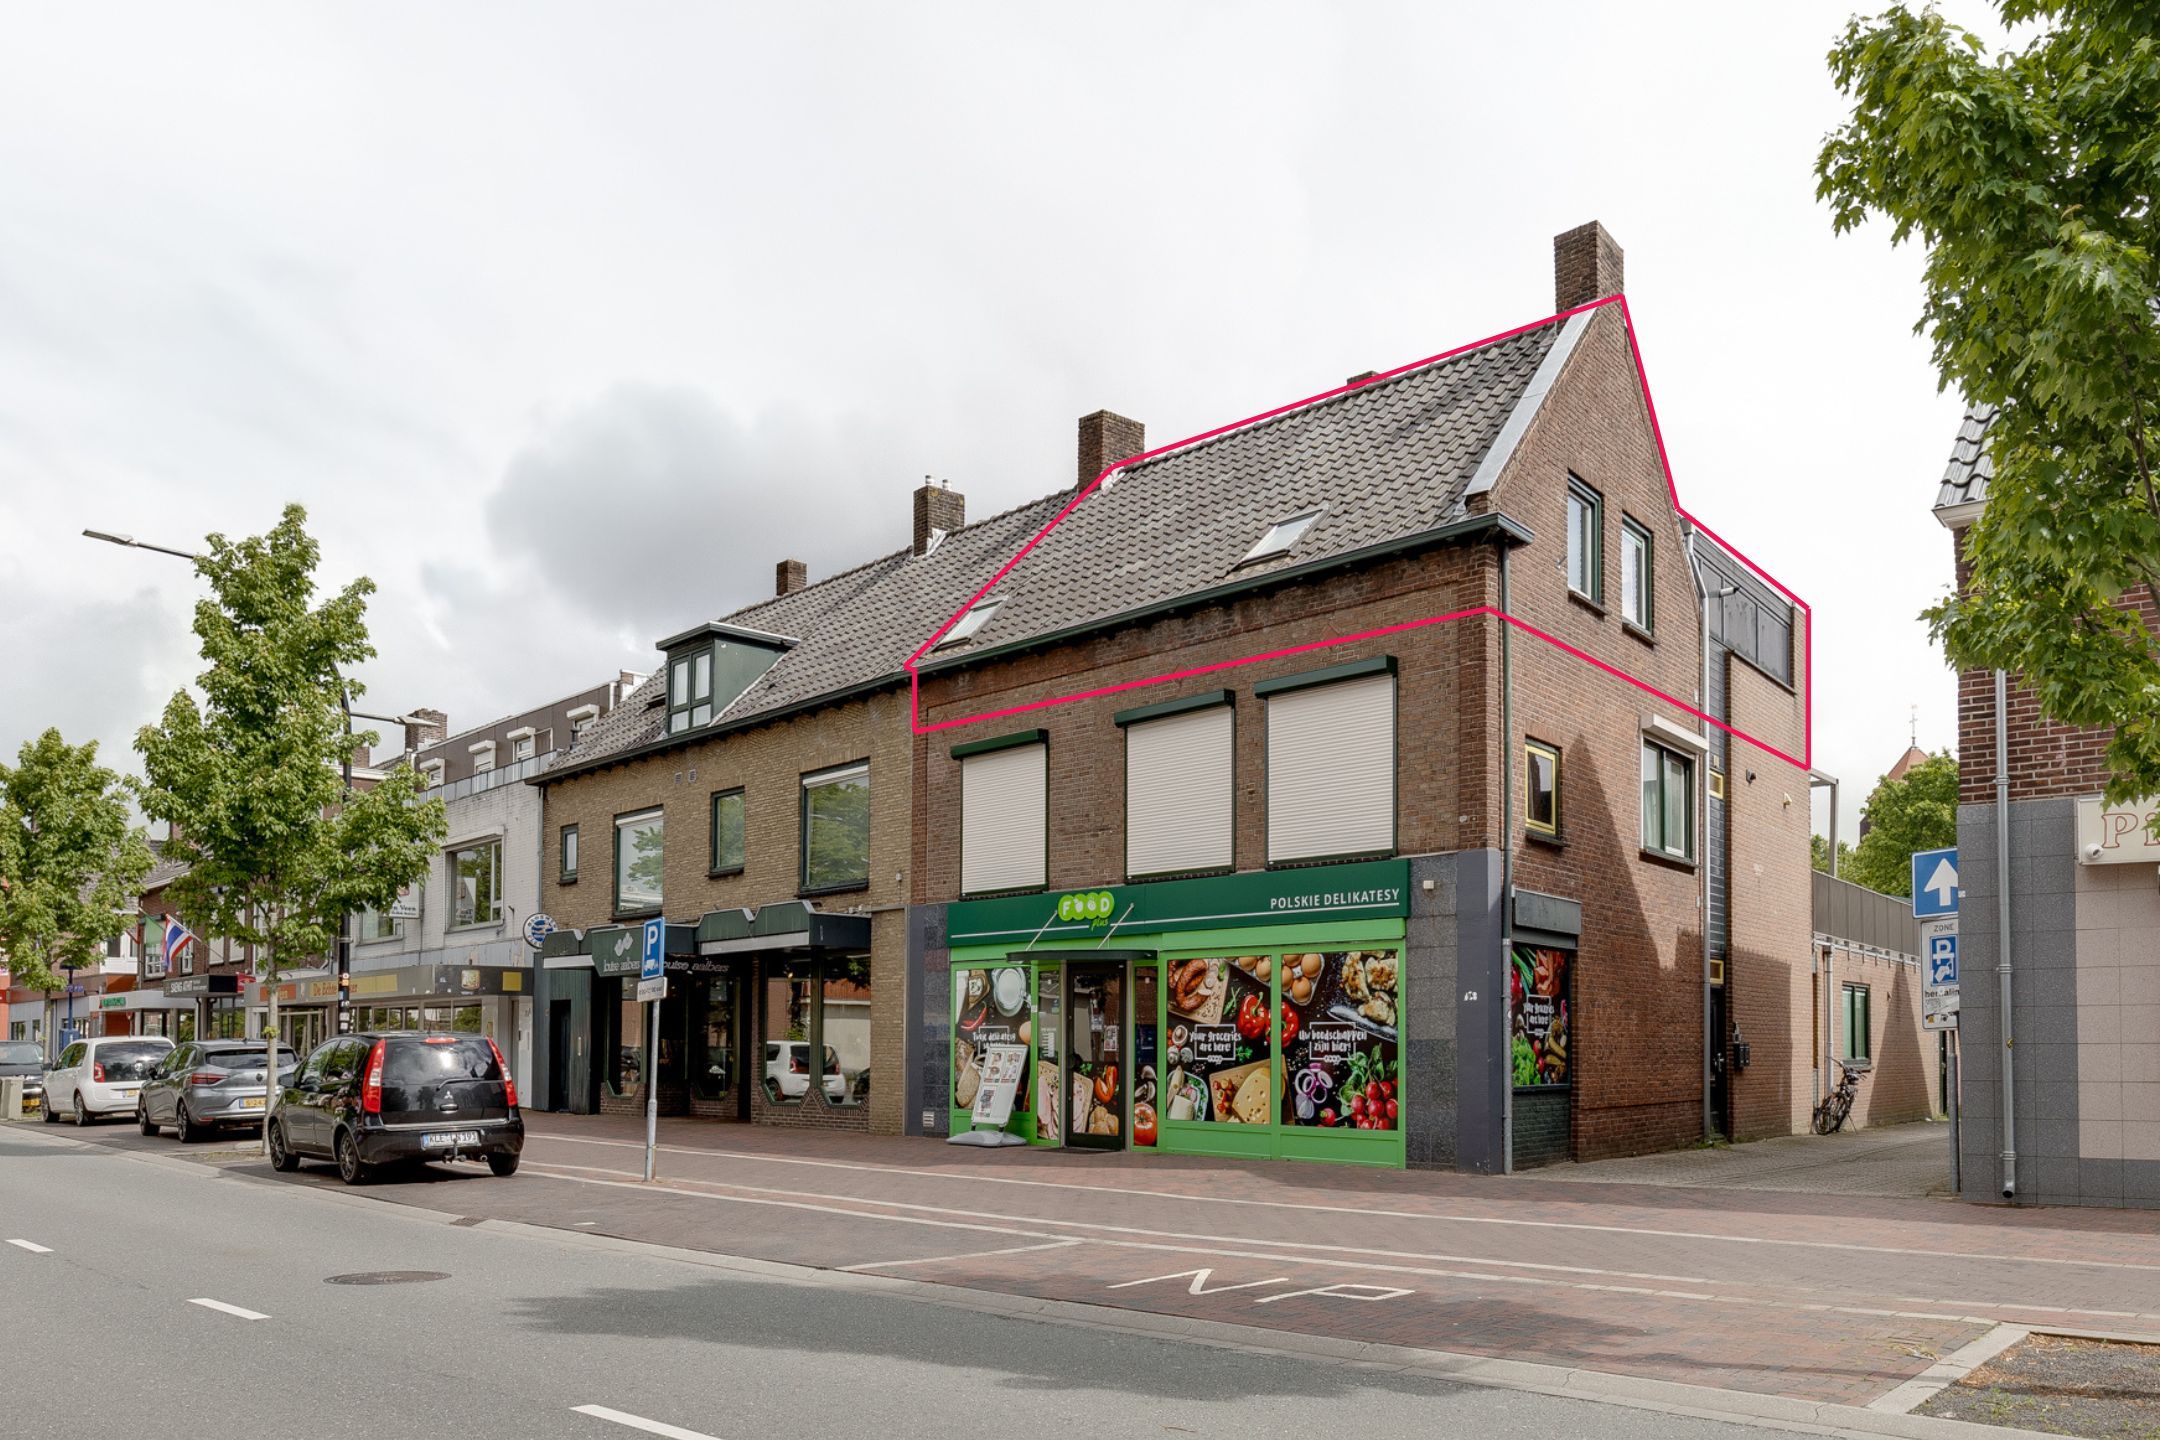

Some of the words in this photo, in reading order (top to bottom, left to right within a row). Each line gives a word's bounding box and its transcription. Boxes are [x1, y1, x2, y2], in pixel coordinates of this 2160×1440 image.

[1270, 894, 1320, 909] POLSKIE
[1324, 888, 1400, 905] DELIKATESY
[1062, 896, 1111, 916] FOOD
[1934, 923, 1954, 932] ZONE
[646, 925, 658, 955] P
[663, 960, 689, 971] ouise
[1924, 988, 1959, 998] heralin
[1189, 1031, 1206, 1042] Your
[1208, 1031, 1242, 1042] groceries
[1298, 1030, 1311, 1040] Uw
[1311, 1029, 1368, 1041] boodschappen
[1199, 1042, 1212, 1052] are
[1314, 1041, 1329, 1053] zijn
[1331, 1041, 1351, 1052] hier!
